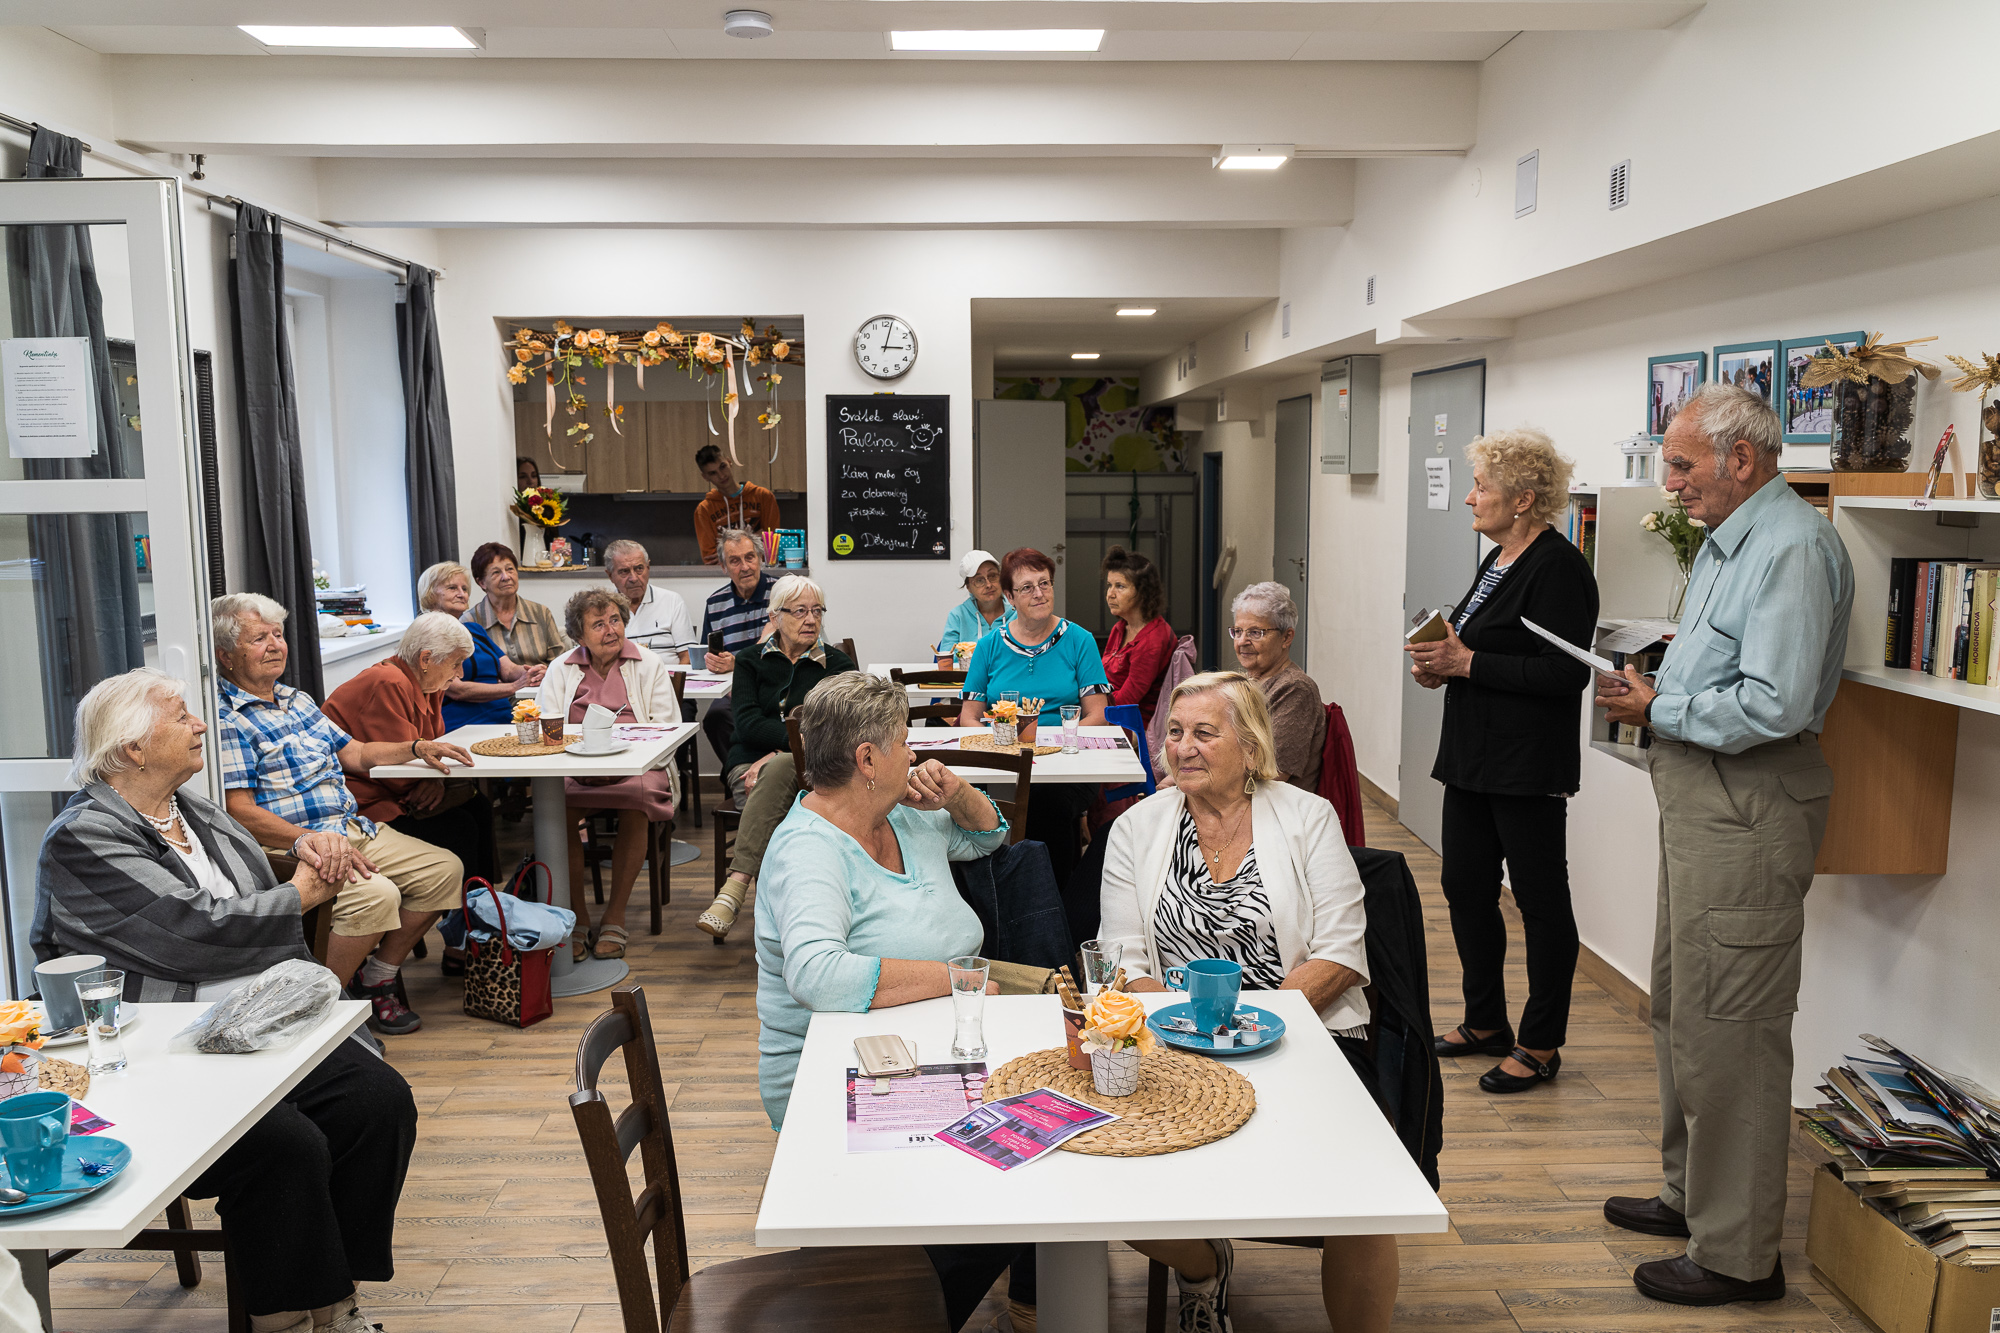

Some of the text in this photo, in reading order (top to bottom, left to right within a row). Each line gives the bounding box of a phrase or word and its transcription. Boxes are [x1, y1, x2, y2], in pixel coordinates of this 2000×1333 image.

[839, 427, 899, 448] Pavlína
[841, 464, 921, 484] Káva nebo čaj
[841, 490, 857, 498] za
[1914, 607, 1920, 618] TO
